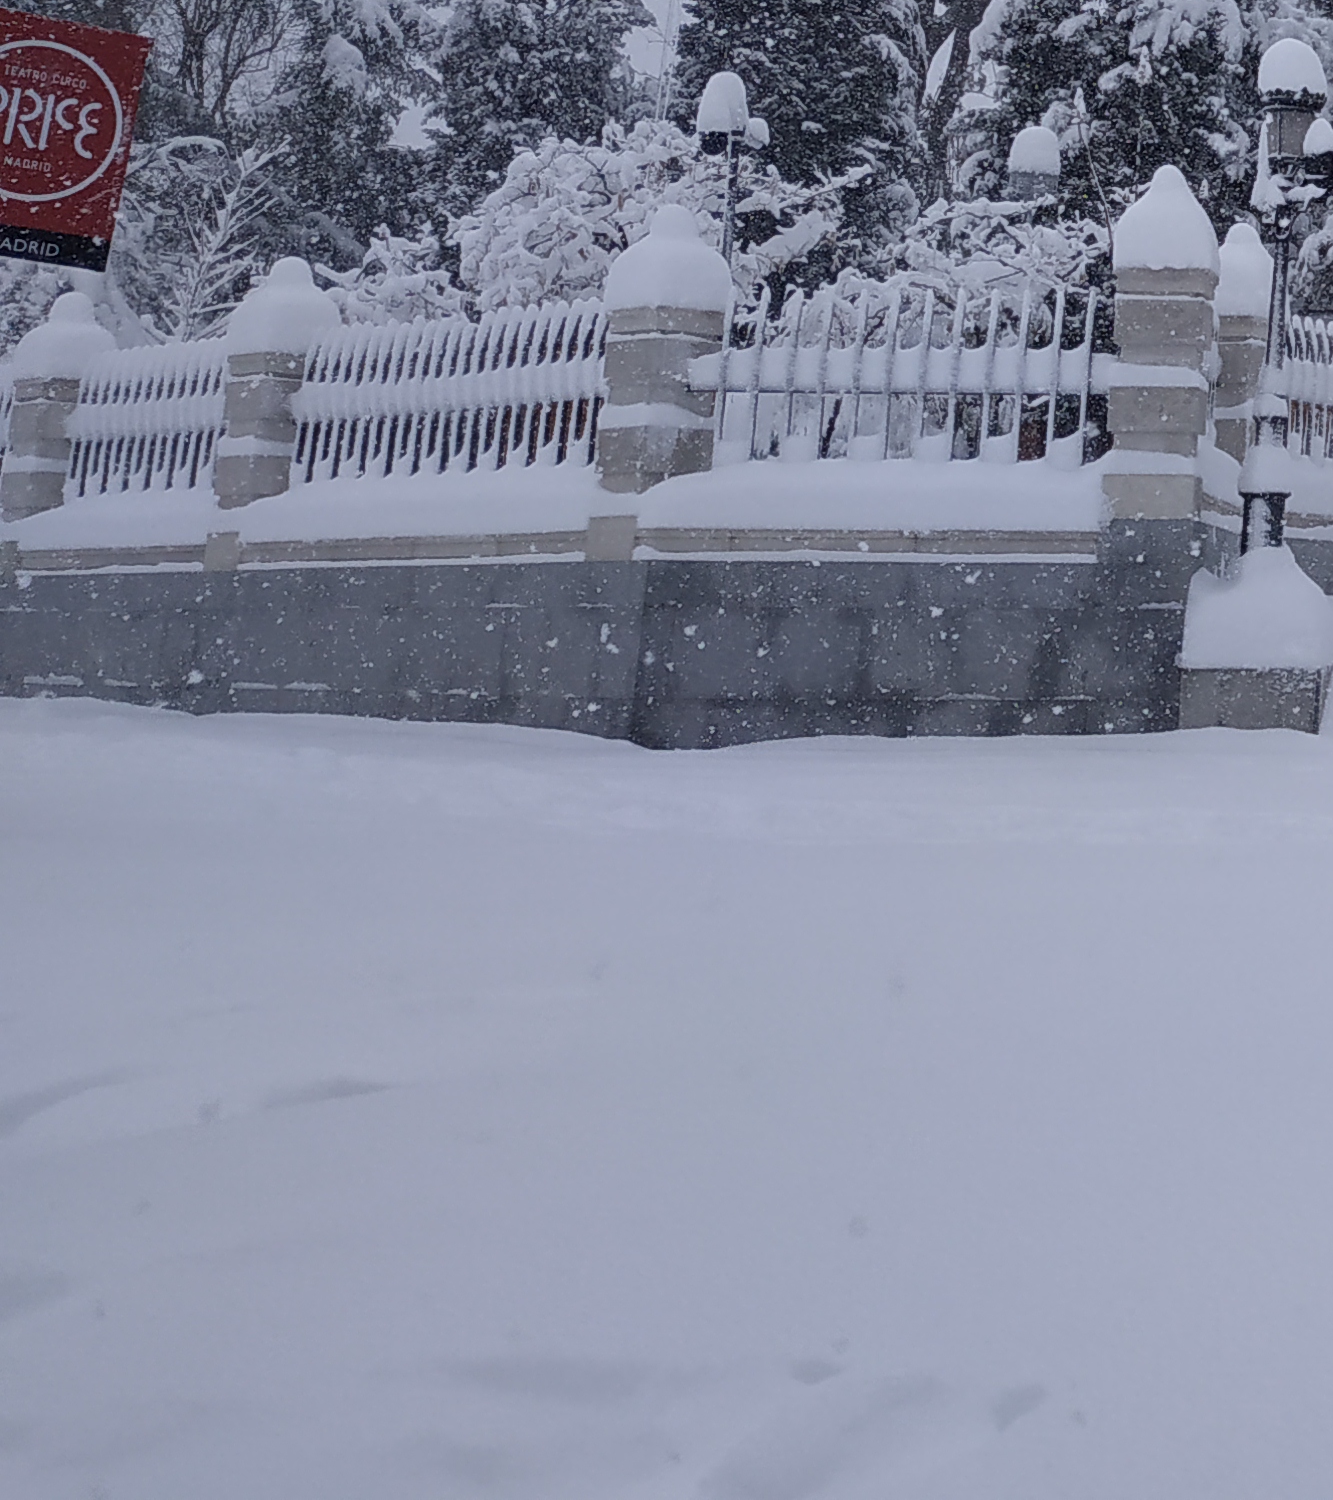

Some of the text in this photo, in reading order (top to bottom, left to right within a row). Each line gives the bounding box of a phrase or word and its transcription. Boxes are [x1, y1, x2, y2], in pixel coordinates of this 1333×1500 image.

[5, 64, 87, 90] TEATRO CIRCO
[3, 156, 52, 173] MADRID
